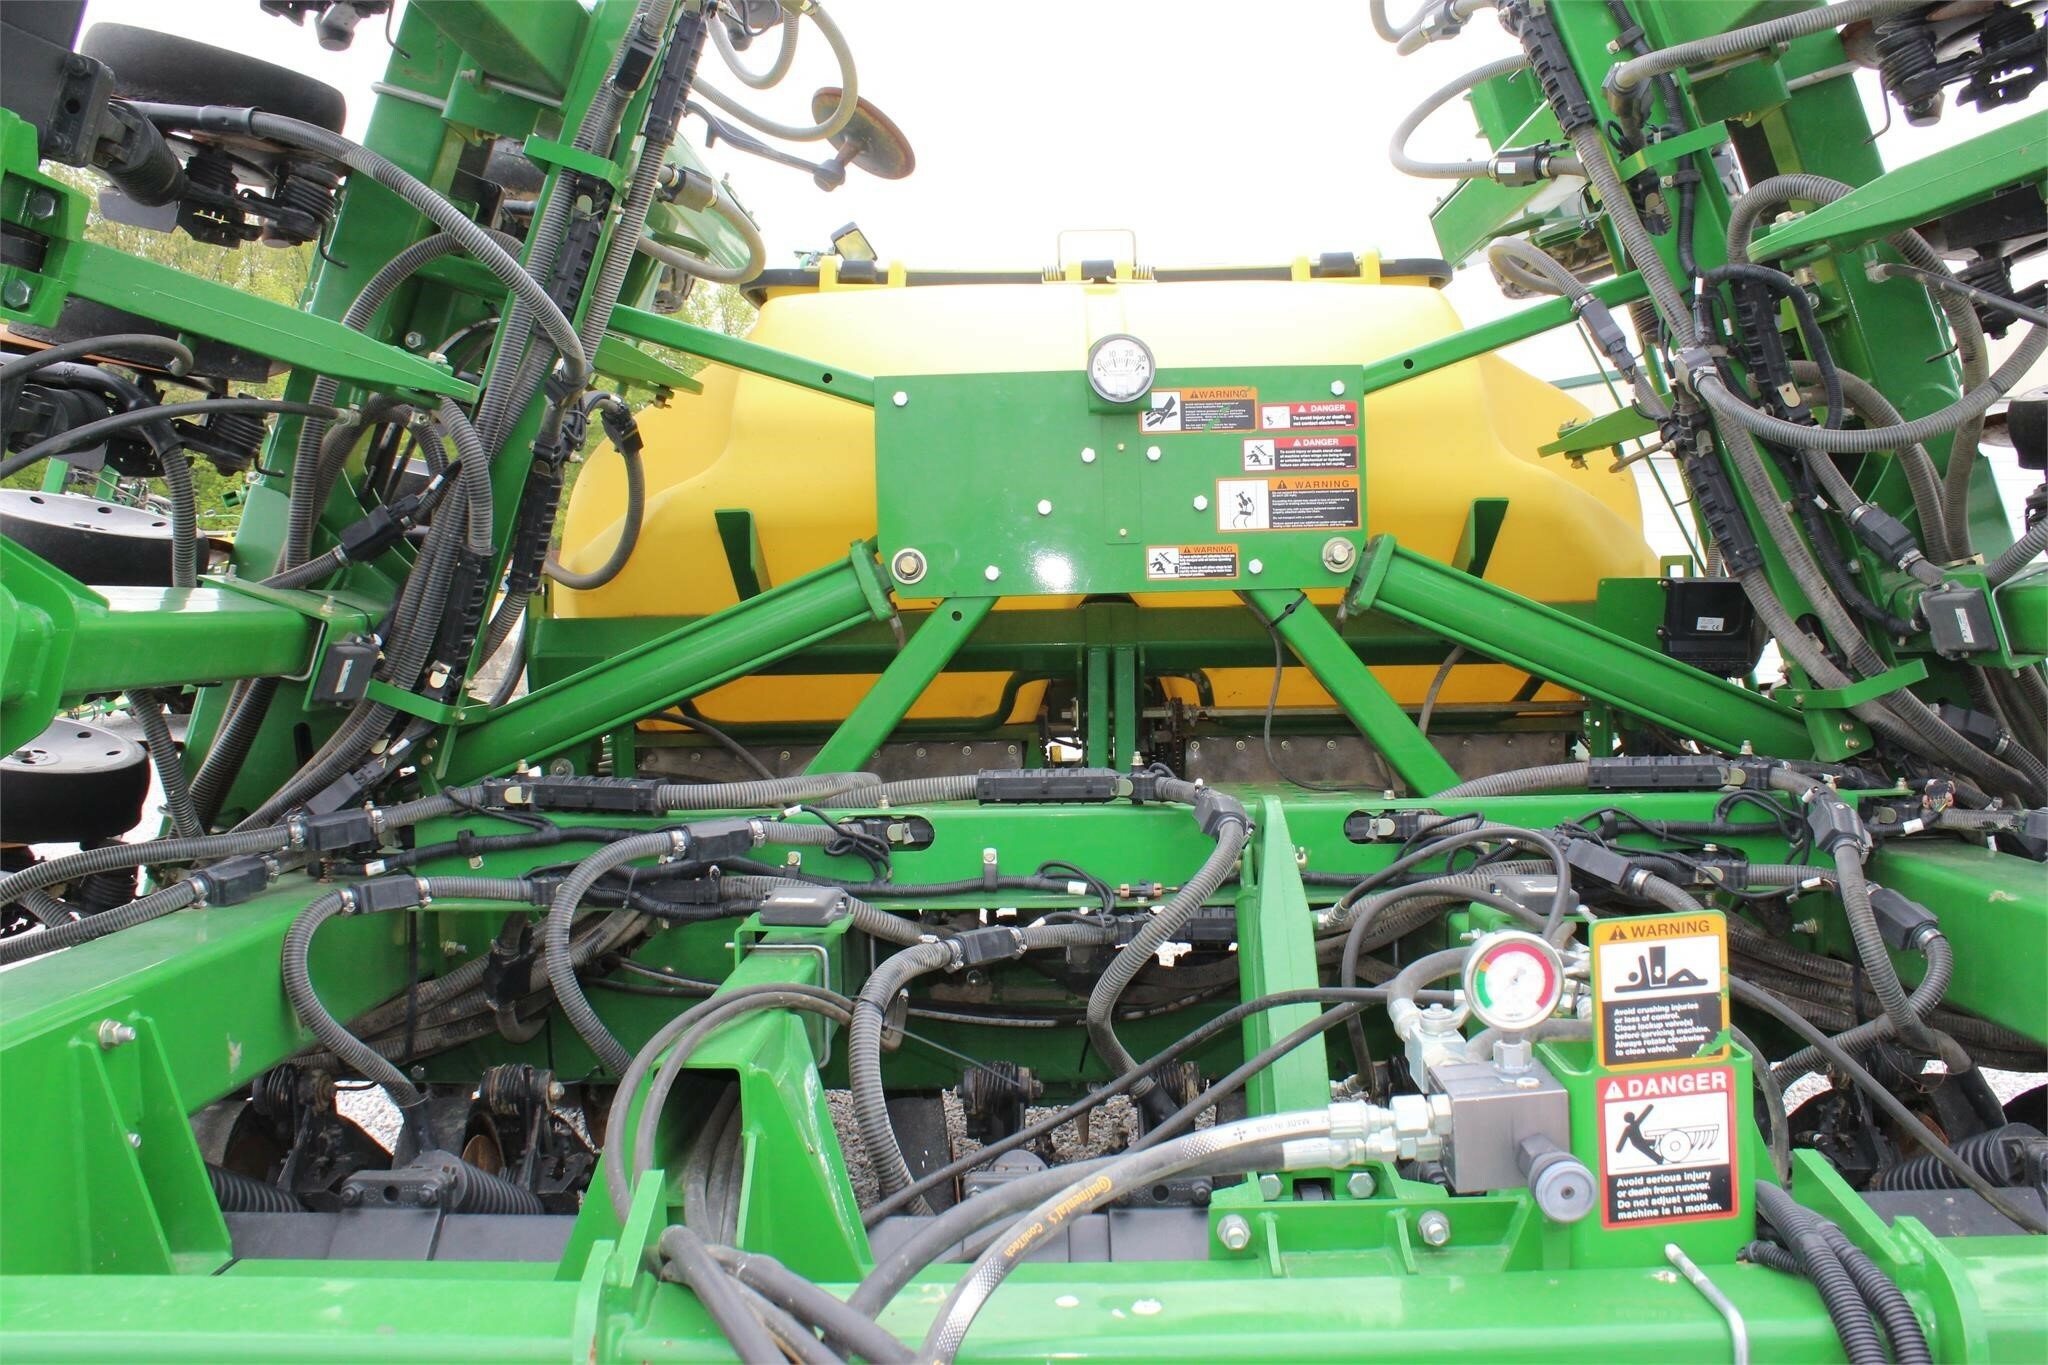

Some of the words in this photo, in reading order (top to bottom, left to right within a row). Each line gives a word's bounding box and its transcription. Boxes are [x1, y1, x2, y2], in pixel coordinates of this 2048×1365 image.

[1109, 350, 1117, 358] 10
[1137, 354, 1146, 363] 30
[1199, 389, 1248, 399] WARNING
[1310, 404, 1346, 412] DANGER
[1303, 438, 1339, 446] DANGER
[1294, 480, 1350, 489] WARNING
[1193, 545, 1233, 553] WARNING
[1630, 920, 1710, 938] WARNING
[1614, 1008, 1635, 1016] Avoid
[1637, 1005, 1669, 1014] crushing
[1671, 1003, 1699, 1011] injuries
[1651, 1012, 1680, 1020] control.
[1638, 1021, 1663, 1030] lockup
[1664, 1018, 1693, 1027] valve(s)
[1615, 1032, 1639, 1040] before
[1641, 1029, 1675, 1038] servicing
[1676, 1026, 1710, 1034] machine.
[1615, 1040, 1642, 1048] Always
[1668, 1034, 1705, 1043] clockwise
[1647, 1044, 1678, 1053] valve(s).
[1627, 1071, 1727, 1098] DANGER
[1617, 1176, 1643, 1187] Avoid
[1646, 1174, 1681, 1184] serious
[1684, 1171, 1711, 1181] injury
[1628, 1187, 1652, 1197] death
[1654, 1186, 1674, 1194] from
[1675, 1182, 1710, 1192] runover.
[1055, 1175, 1112, 1220] Continental
[1617, 1200, 1631, 1209] Do
[1633, 1199, 1649, 1207] not
[1651, 1195, 1680, 1206] adjust
[1683, 1192, 1708, 1202] while
[1618, 1208, 1659, 1220] machine
[1662, 1207, 1671, 1215] is
[1673, 1206, 1682, 1214] in
[1685, 1202, 1722, 1213] motion.
[1004, 1222, 1044, 1258] ContiTech
